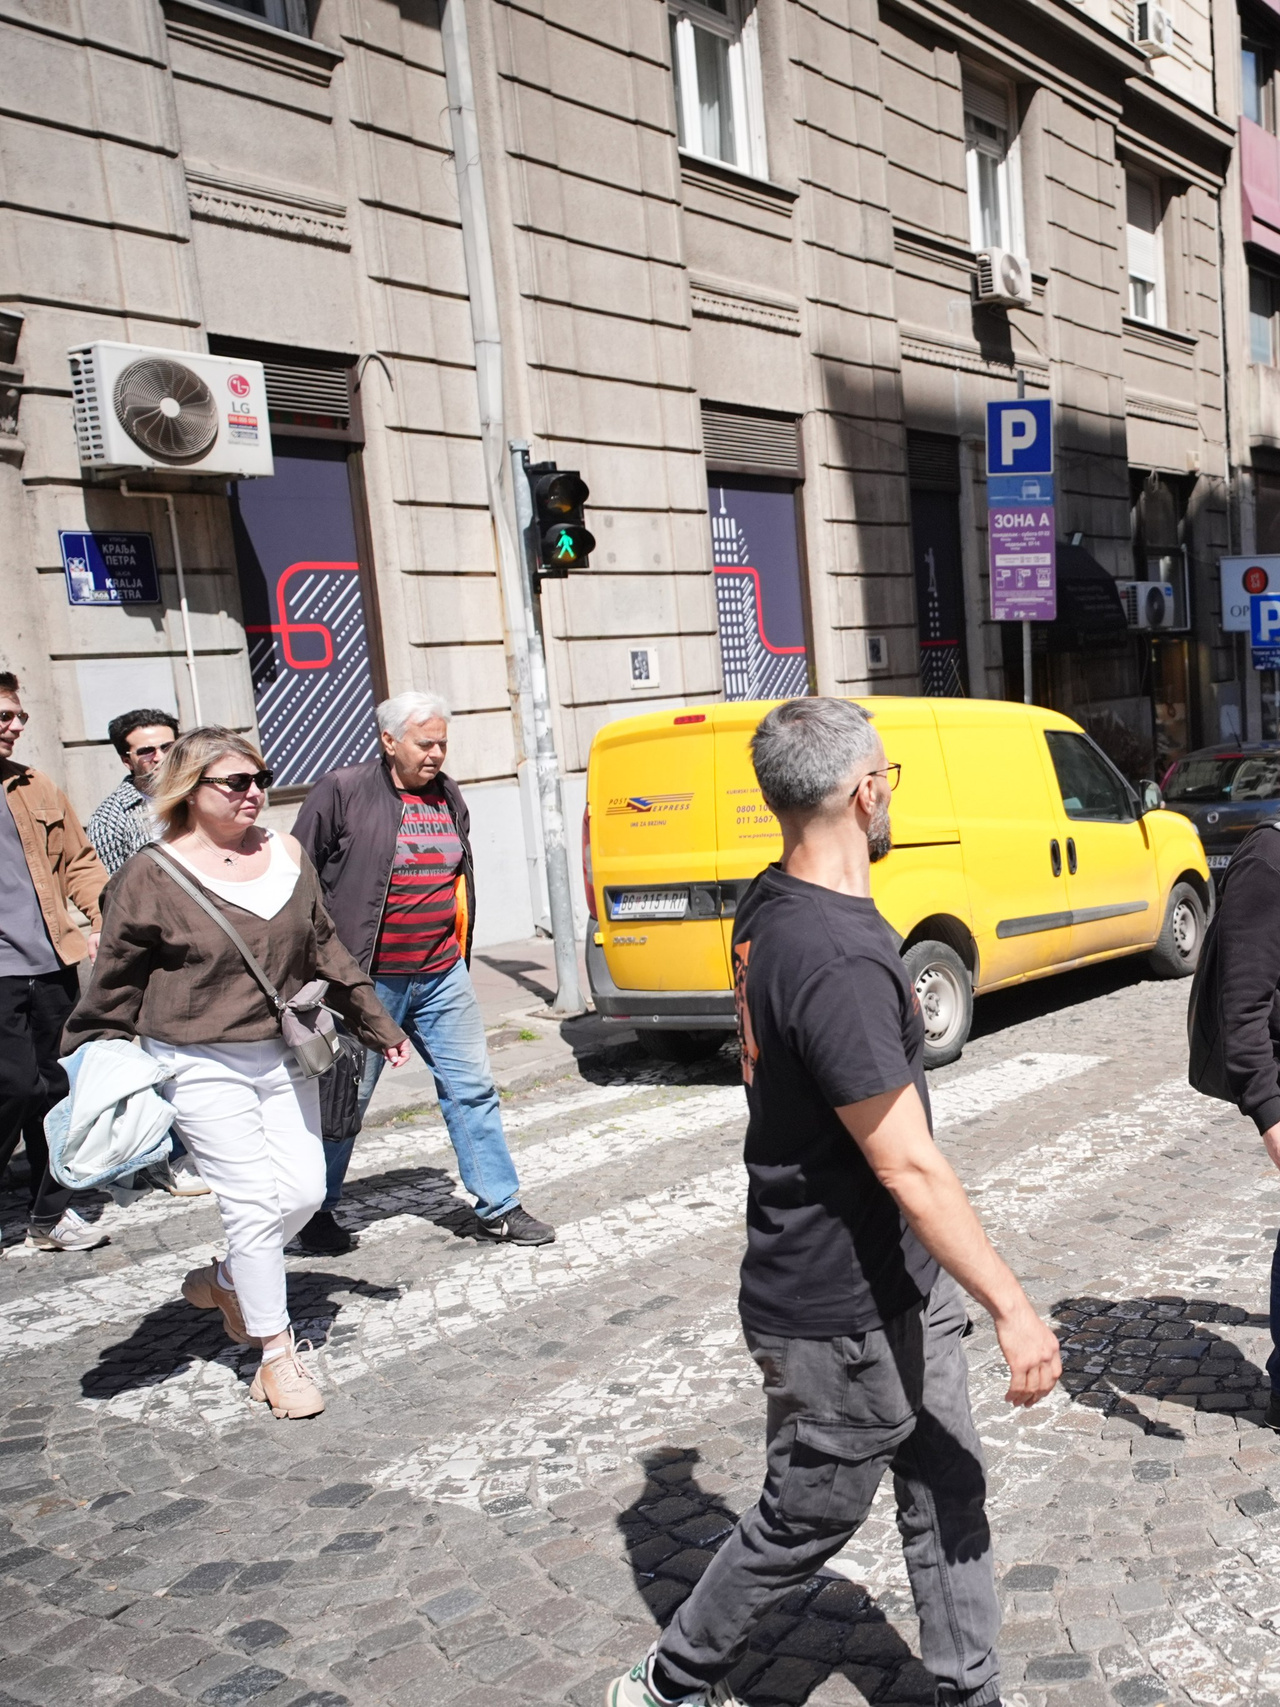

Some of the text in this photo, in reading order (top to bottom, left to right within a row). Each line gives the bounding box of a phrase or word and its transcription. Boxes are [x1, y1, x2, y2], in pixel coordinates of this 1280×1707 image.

[231, 401, 251, 414] LG
[1001, 409, 1037, 466] P
[994, 512, 1050, 528] ЗОНА А
[102, 544, 136, 554] КРАЉА
[105, 555, 136, 566] ПЕТРА
[105, 578, 143, 588] KRALJA
[110, 589, 142, 599] PETRA
[608, 797, 627, 805] POST
[653, 803, 691, 812] EXPRESS
[736, 805, 756, 813] 0800
[736, 815, 774, 824] 011 3607
[399, 820, 434, 837] NDER
[621, 894, 636, 911] BG
